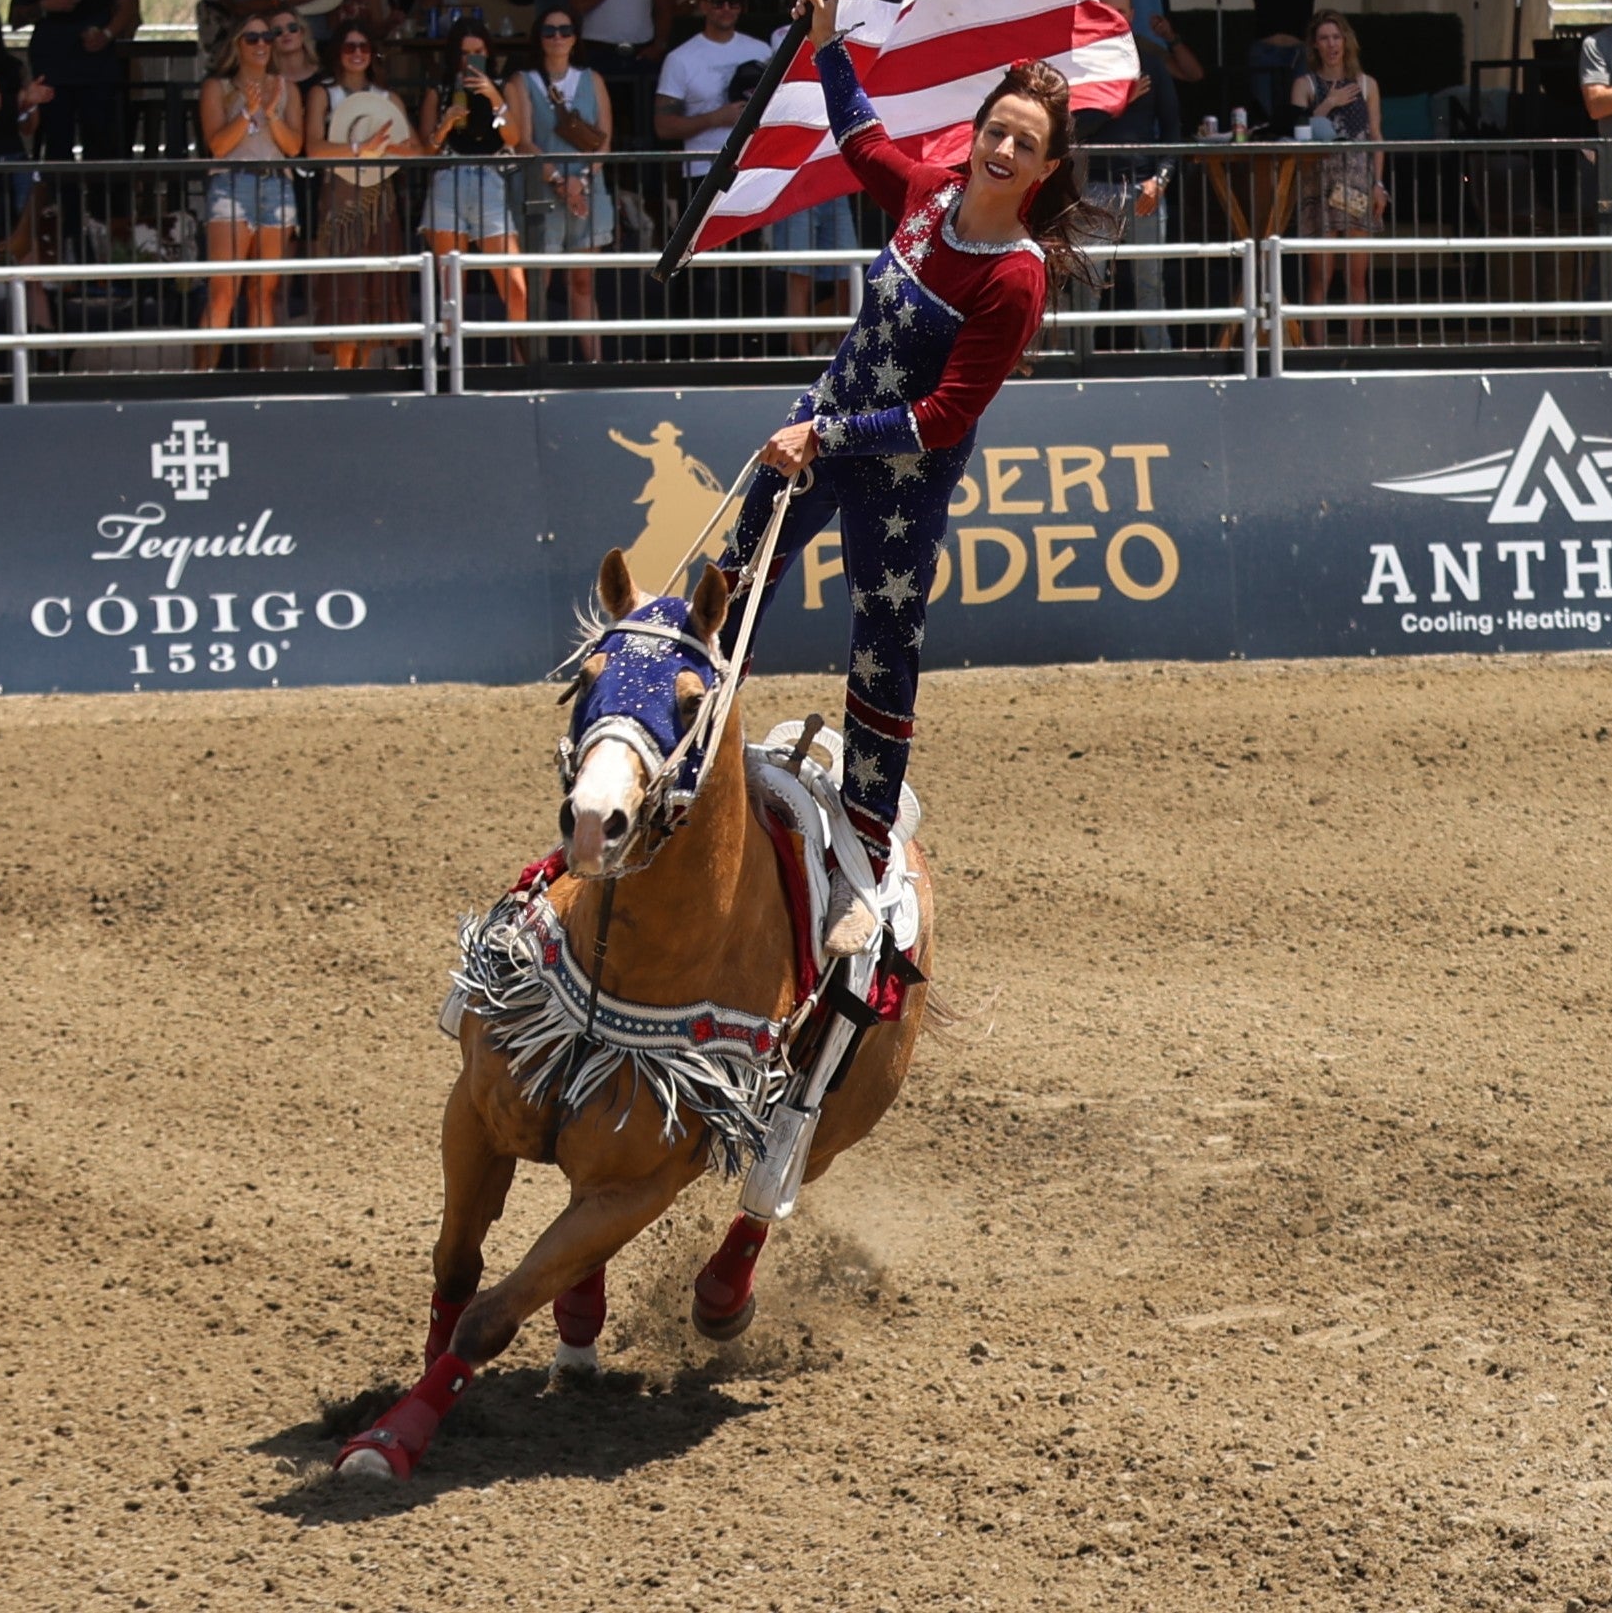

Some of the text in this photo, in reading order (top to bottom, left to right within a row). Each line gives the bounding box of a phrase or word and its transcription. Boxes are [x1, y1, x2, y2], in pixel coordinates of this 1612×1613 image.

[91, 502, 298, 590] Tequila
[30, 582, 368, 638] CÓDIGO
[1400, 611, 1495, 636] Cooling
[1506, 606, 1602, 633] Heating
